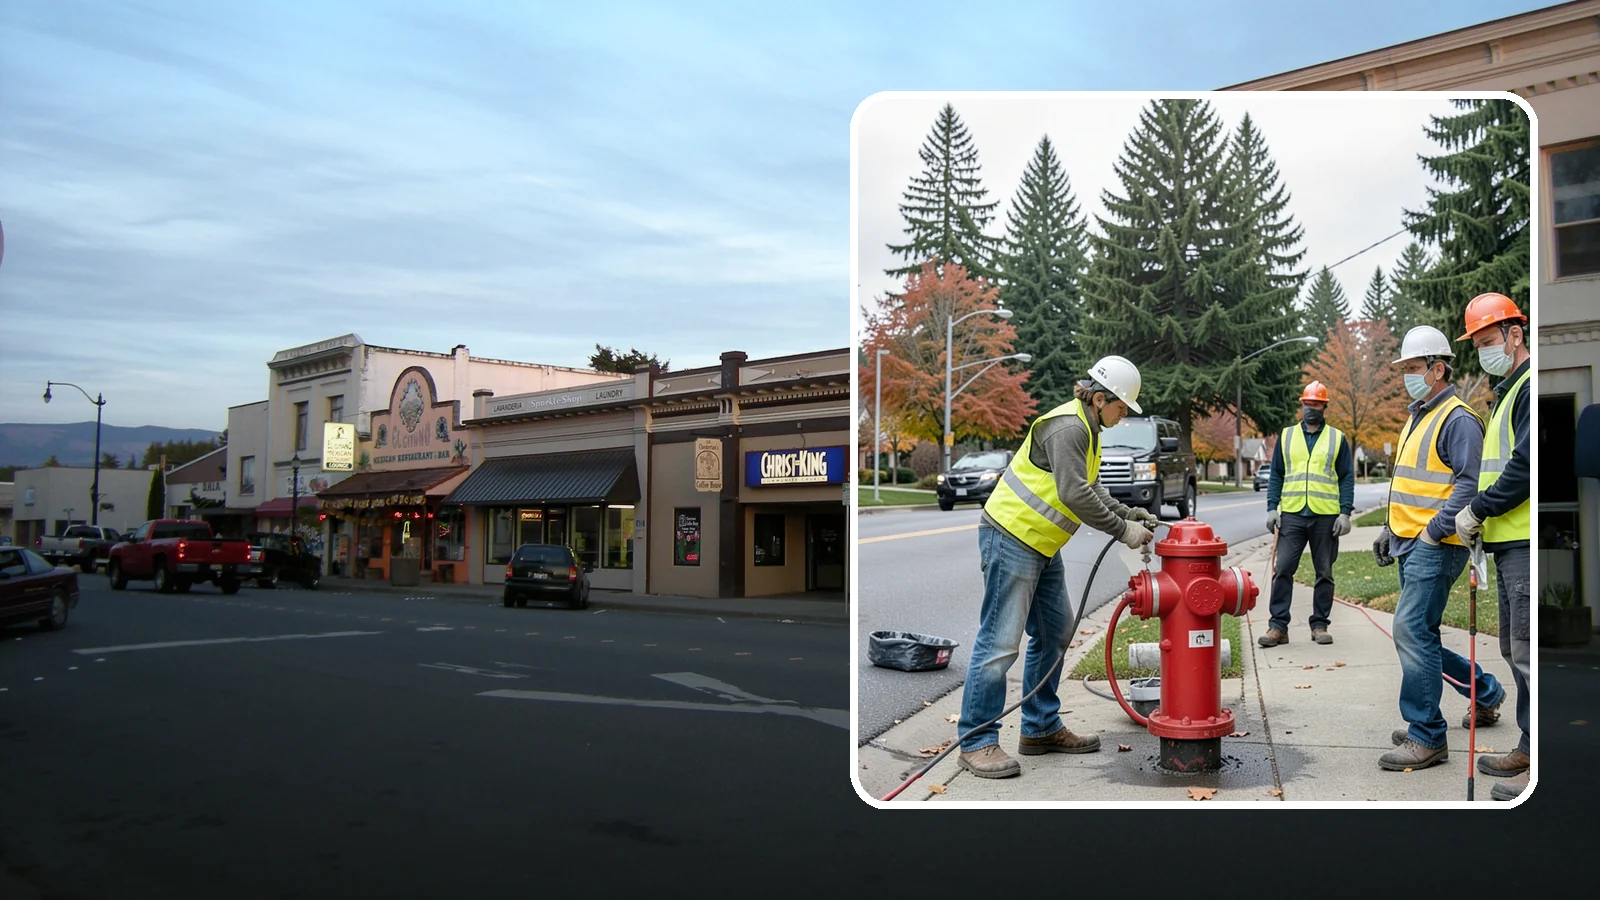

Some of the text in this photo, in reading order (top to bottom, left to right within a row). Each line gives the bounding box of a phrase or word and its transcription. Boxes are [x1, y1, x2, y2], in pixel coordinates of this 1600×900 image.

[493, 402, 523, 412] LAVANDERIA
[561, 395, 583, 404] Shop
[595, 389, 624, 400] LAUNDRY
[373, 450, 450, 464] MEXICAN RESTAURANT BAR
[761, 450, 827, 478] CHRIST KING
